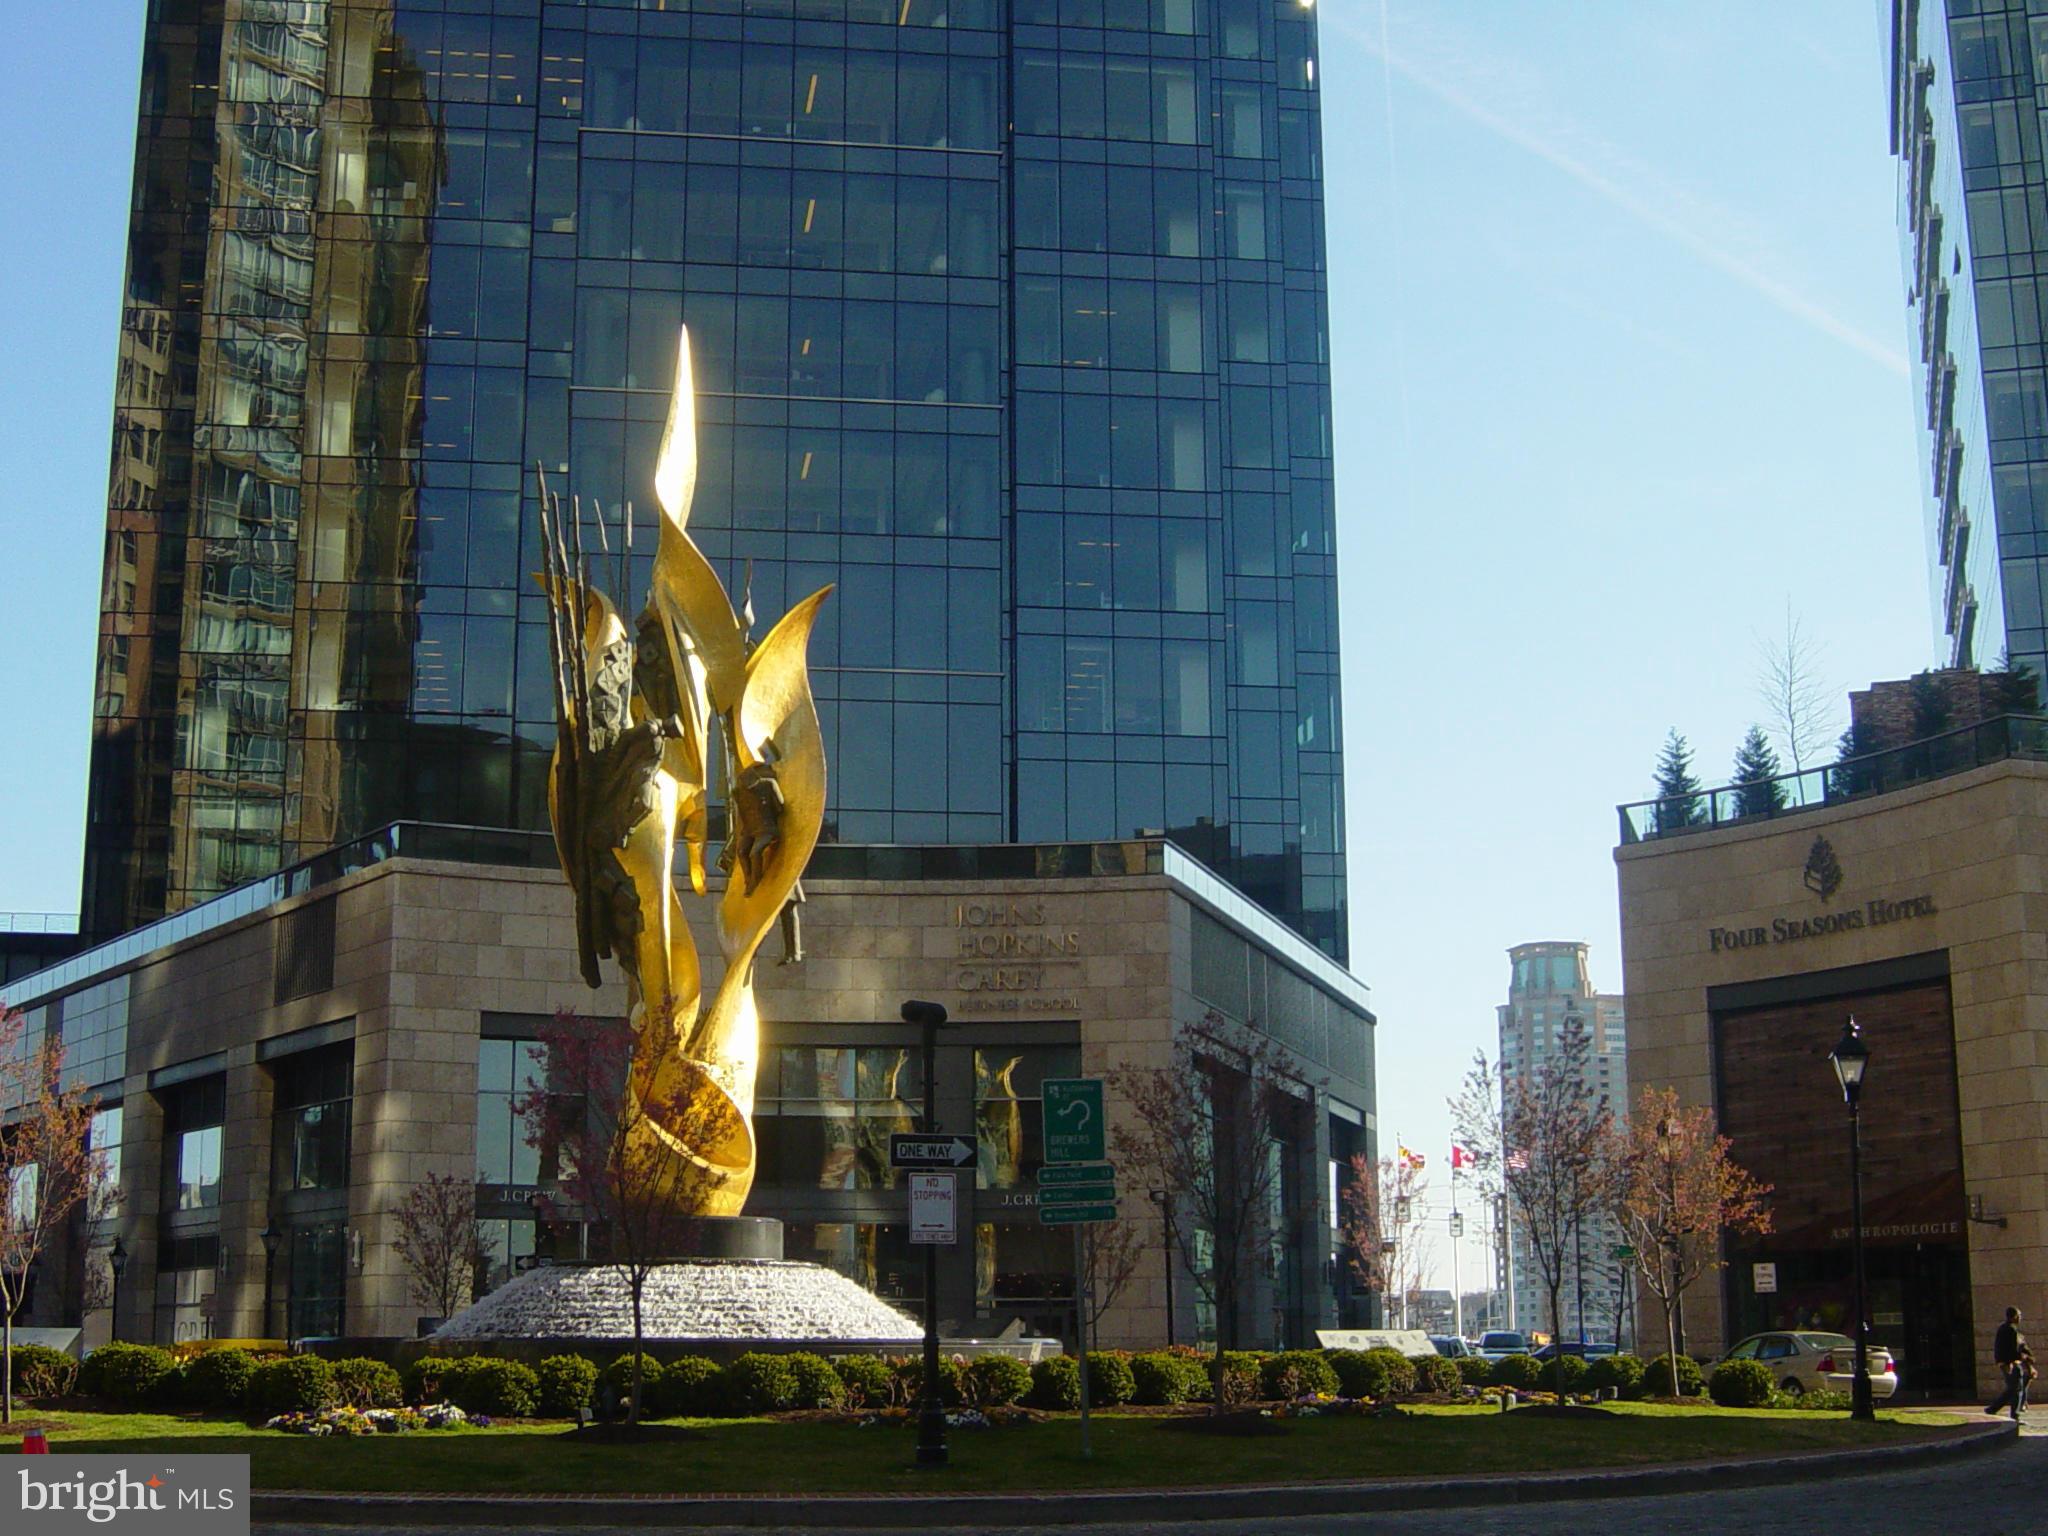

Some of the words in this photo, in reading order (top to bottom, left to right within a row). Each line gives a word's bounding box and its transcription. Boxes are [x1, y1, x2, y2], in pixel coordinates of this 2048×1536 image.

[955, 904, 1047, 928] JOHNS
[1709, 926, 1767, 953] FOUR
[1773, 909, 1865, 944] SEASONS
[1866, 895, 1938, 926] HOTEL
[958, 931, 1080, 956] HOPKINS
[957, 970, 1046, 992] CAREY
[899, 1144, 923, 1158] ONE
[927, 1144, 952, 1159] WAY
[925, 1178, 940, 1187] NO
[913, 1189, 952, 1201] STOPPING
[1830, 1221, 1958, 1240] ANHROPOLOGIE
